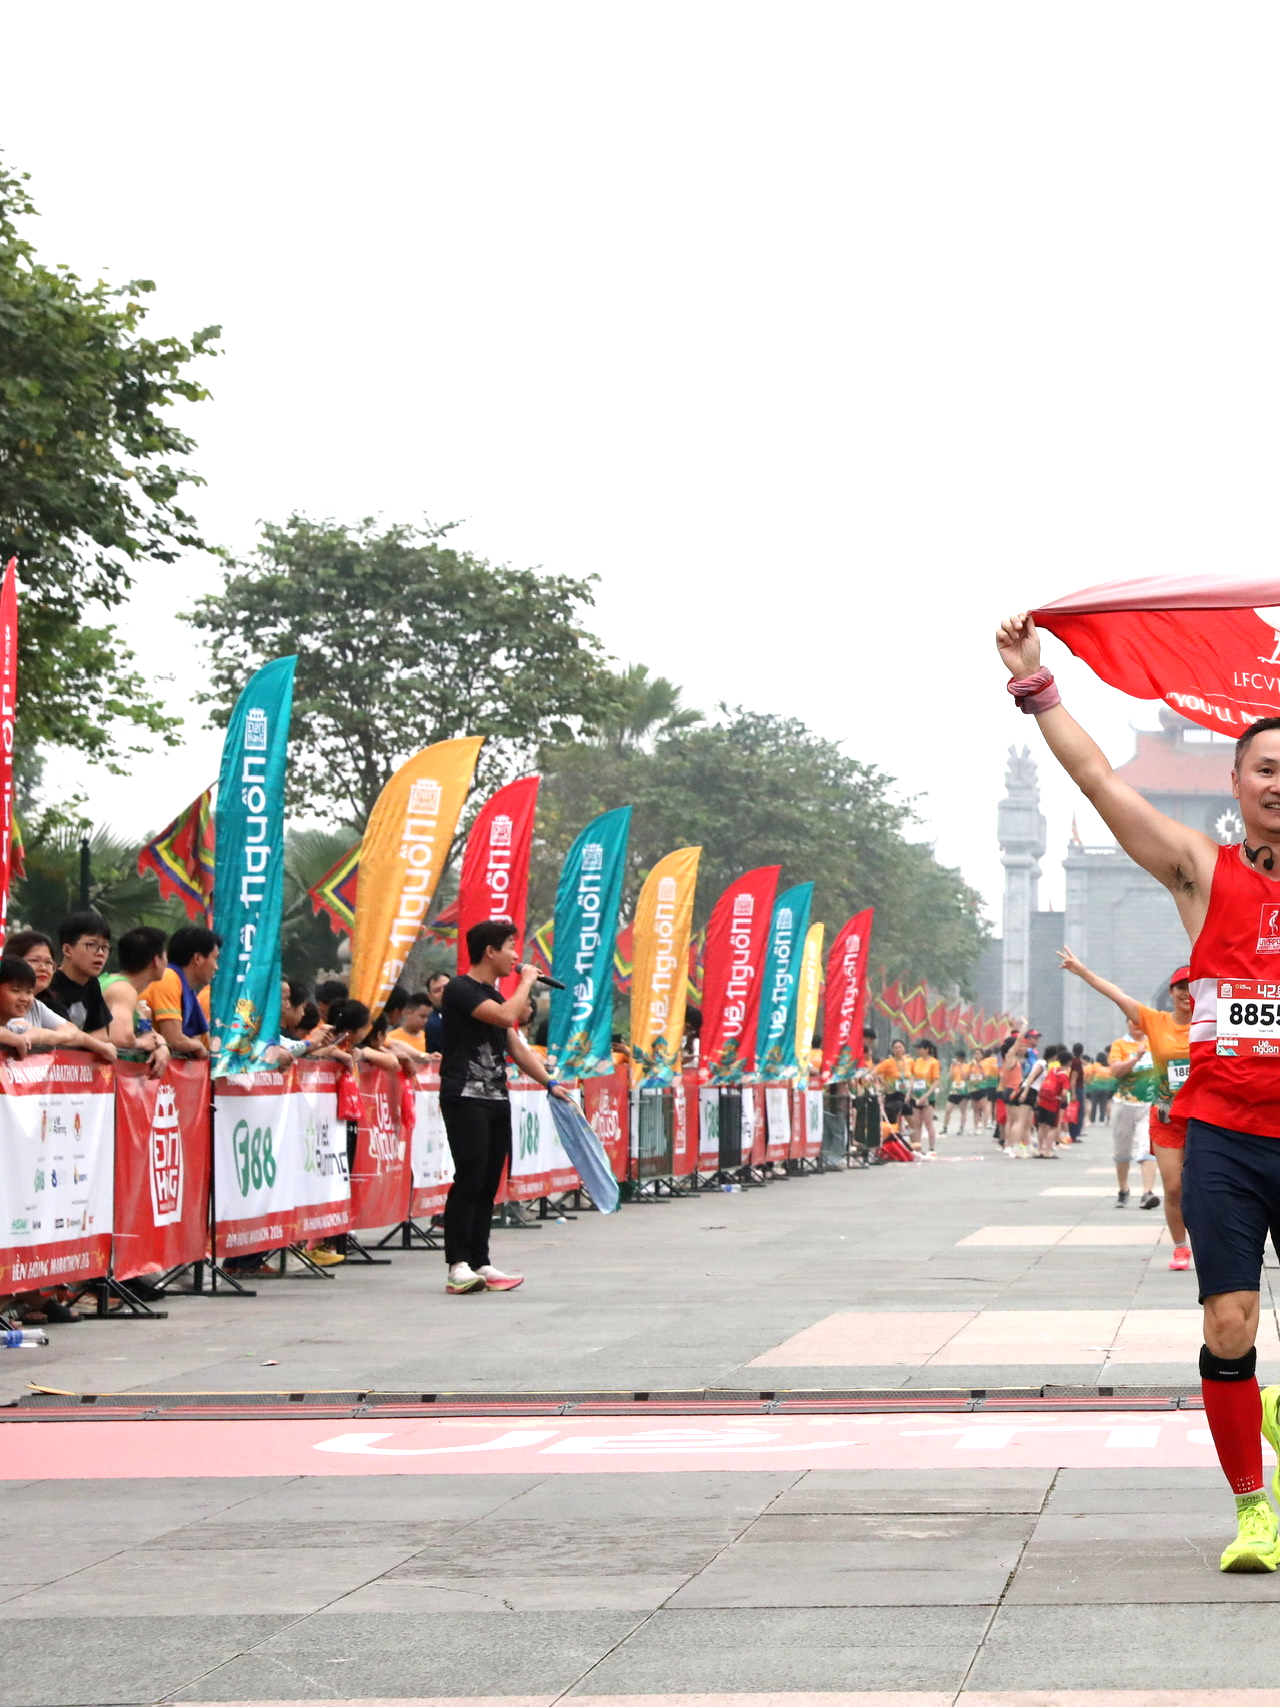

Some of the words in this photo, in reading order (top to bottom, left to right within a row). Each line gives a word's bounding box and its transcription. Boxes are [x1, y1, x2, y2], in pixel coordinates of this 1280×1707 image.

[1257, 984, 1276, 998] 42
[233, 1119, 276, 1198] F88
[726, 1414, 1061, 1427] CHÀO
